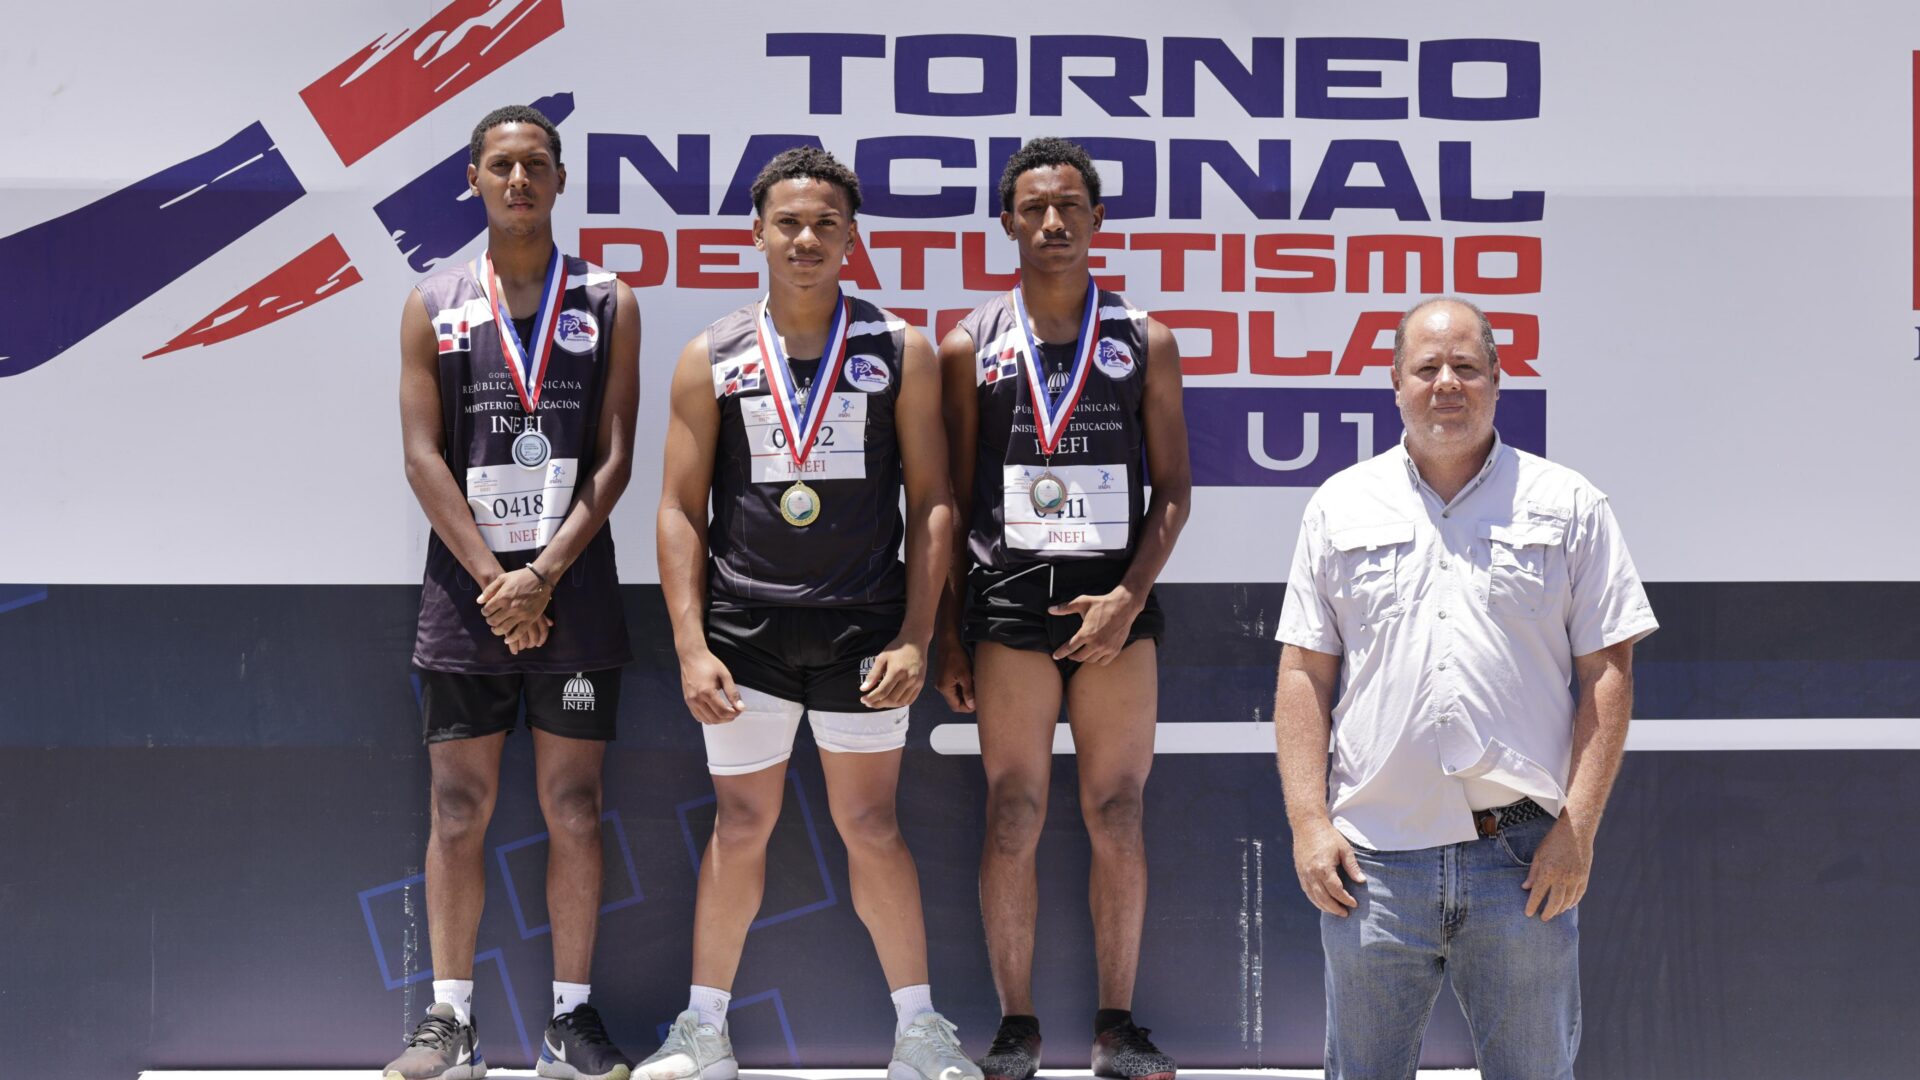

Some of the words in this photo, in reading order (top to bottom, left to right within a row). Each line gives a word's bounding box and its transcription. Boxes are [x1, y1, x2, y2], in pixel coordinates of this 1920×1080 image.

[765, 32, 1541, 121] TORNEO
[587, 132, 1546, 223] NACIONAL
[579, 227, 760, 290] DE
[881, 307, 1542, 378] OLAR
[541, 380, 583, 391] NICANA
[536, 399, 581, 411] UCACIÓN
[1074, 402, 1121, 413] INICANA
[490, 415, 543, 434] INEFI
[1010, 423, 1039, 434] INISTE
[1069, 420, 1123, 432] EDUCACIÓN
[771, 425, 835, 449] 02
[1247, 410, 1374, 471] U1
[786, 459, 827, 474] INEFI
[492, 494, 544, 519] 0418
[1047, 530, 1087, 544] INEFI
[562, 700, 595, 711] INEFI
